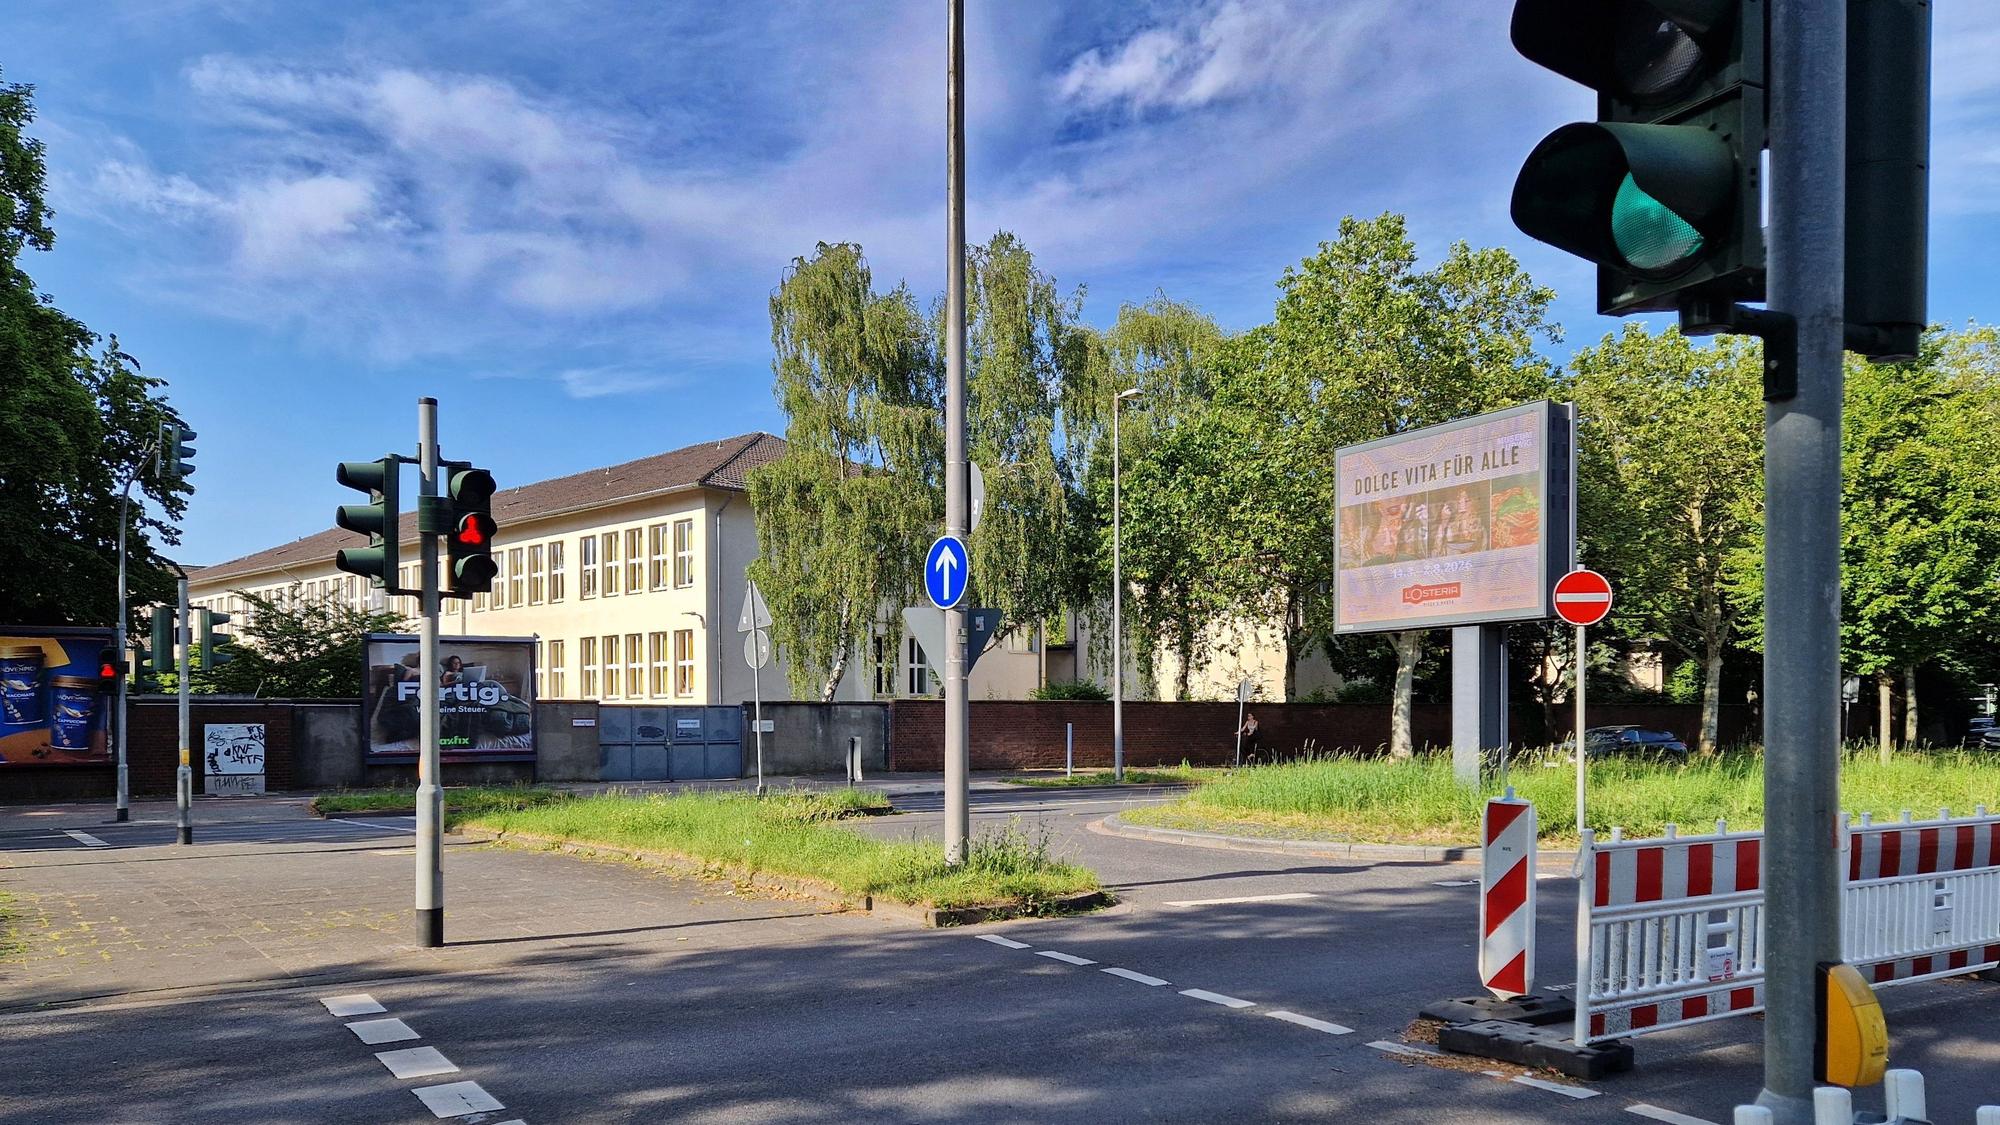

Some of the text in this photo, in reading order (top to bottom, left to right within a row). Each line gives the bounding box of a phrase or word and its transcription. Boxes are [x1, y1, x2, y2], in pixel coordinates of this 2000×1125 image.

[1355, 445, 1519, 495] DOLCE VITA FÜR ALLE
[398, 682, 508, 705] Frtig.
[439, 736, 469, 745] axfix
